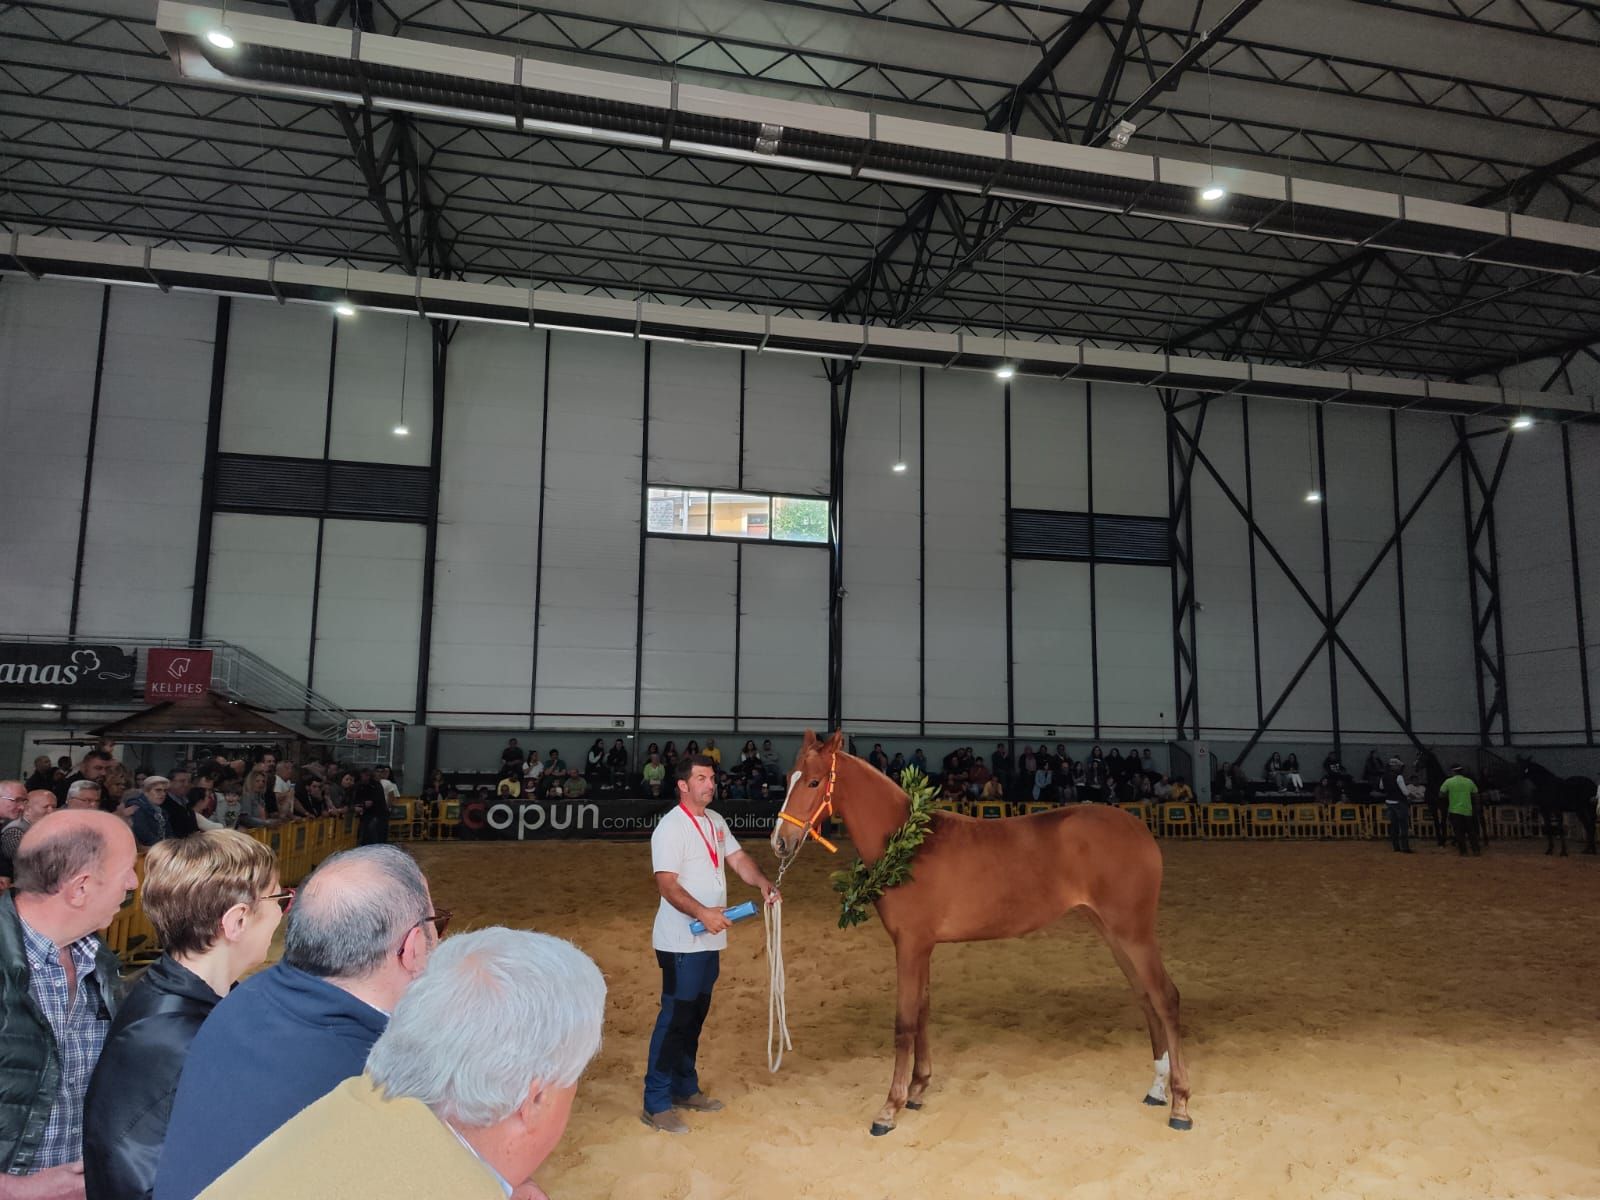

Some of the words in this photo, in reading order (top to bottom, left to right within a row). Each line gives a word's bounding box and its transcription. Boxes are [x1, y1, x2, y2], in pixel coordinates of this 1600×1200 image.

[0, 663, 79, 685] anas
[151, 682, 203, 694] KELPIES
[463, 803, 600, 840] copun
